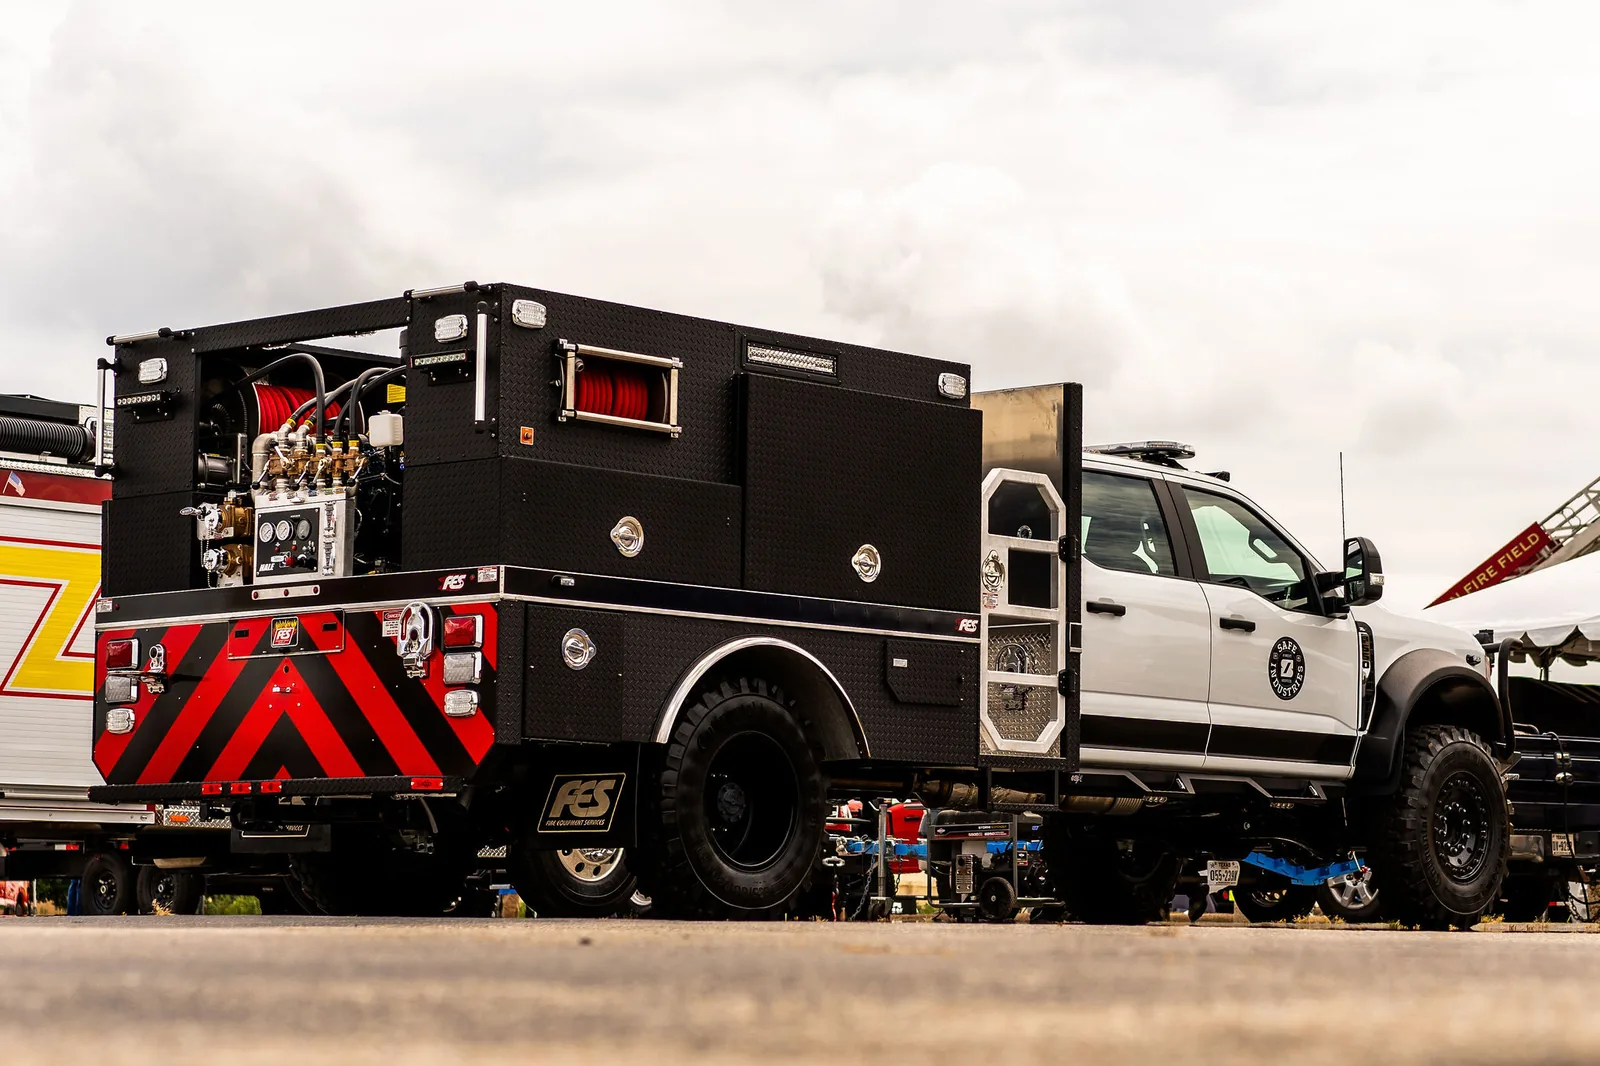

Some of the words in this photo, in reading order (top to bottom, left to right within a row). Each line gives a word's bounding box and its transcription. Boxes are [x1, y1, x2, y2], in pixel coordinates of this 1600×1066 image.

[259, 563, 275, 571] HALE
[1463, 565, 1498, 594] FIRE
[1497, 533, 1540, 569] FIELD
[441, 574, 467, 590] FES
[958, 618, 979, 632] FES
[1277, 641, 1297, 654] SAFE
[1270, 662, 1304, 697] INDUSTRIES
[548, 779, 617, 818] FES
